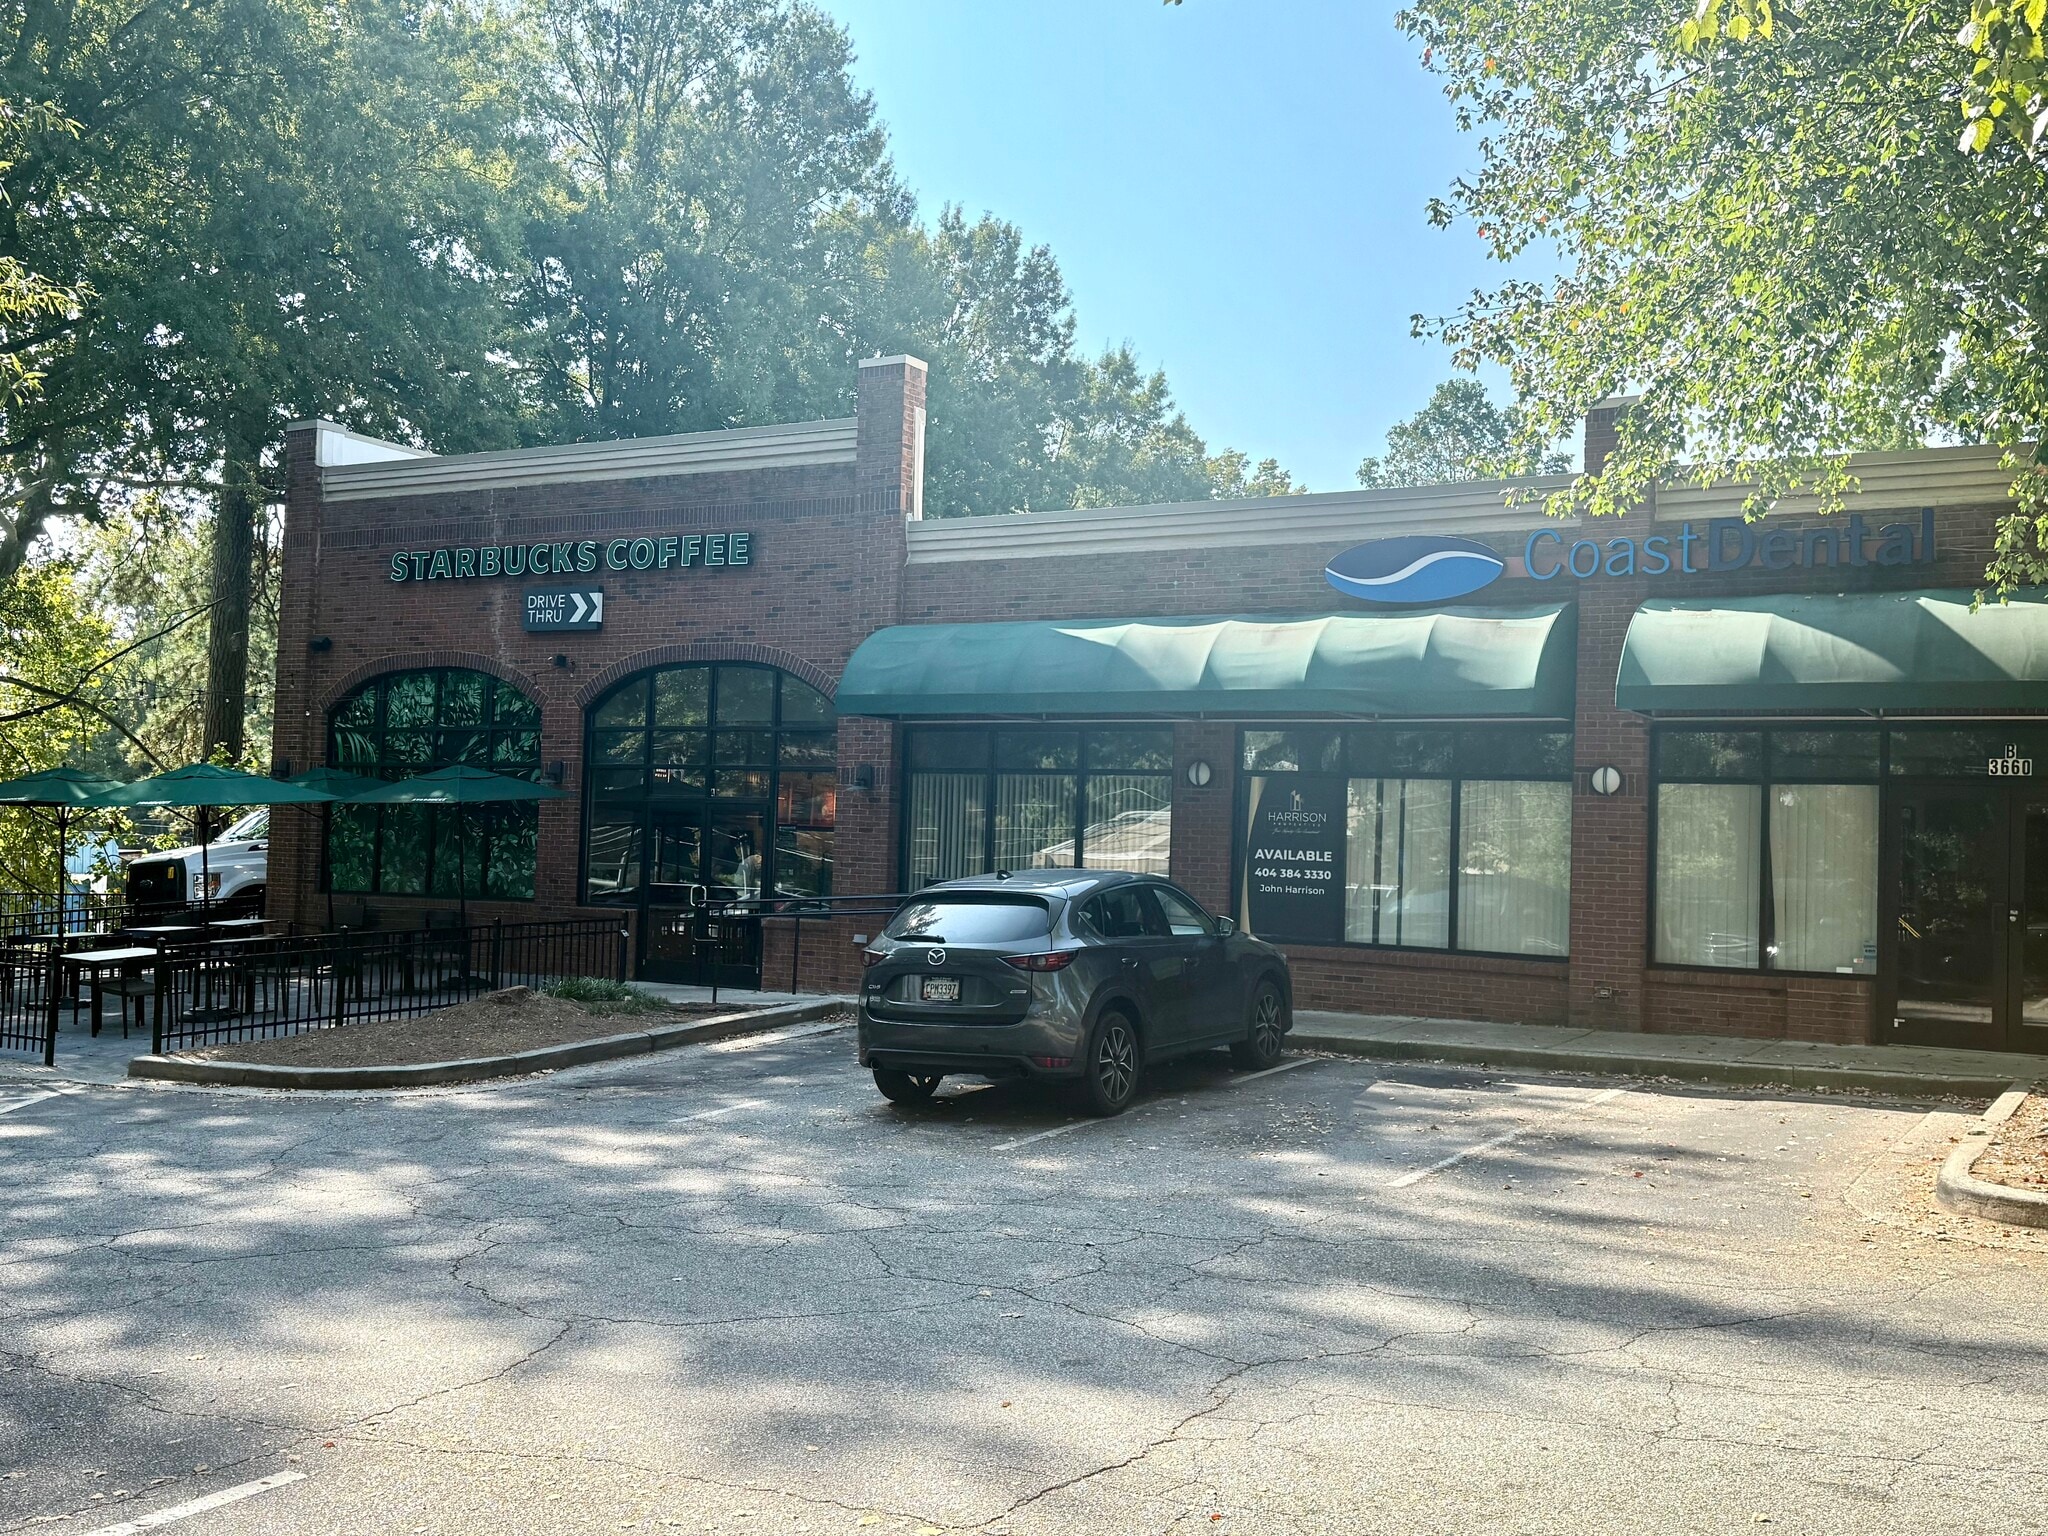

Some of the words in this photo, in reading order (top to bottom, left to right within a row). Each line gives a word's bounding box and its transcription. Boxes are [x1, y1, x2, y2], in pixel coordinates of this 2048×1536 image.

[390, 541, 597, 582] STARBUCKS
[606, 532, 750, 571] COFFEE
[527, 594, 566, 609] DRIVE
[527, 609, 563, 623] THRU
[2006, 743, 2016, 759] B
[1990, 759, 2031, 775] 3660
[1268, 811, 1327, 823] HARRISON
[1254, 848, 1333, 862] AVAILABLE
[1254, 867, 1277, 878] 404
[1279, 868, 1302, 879] 384
[1304, 869, 1332, 880] 3330
[1259, 884, 1283, 893] John
[1285, 885, 1325, 895] Harrison
